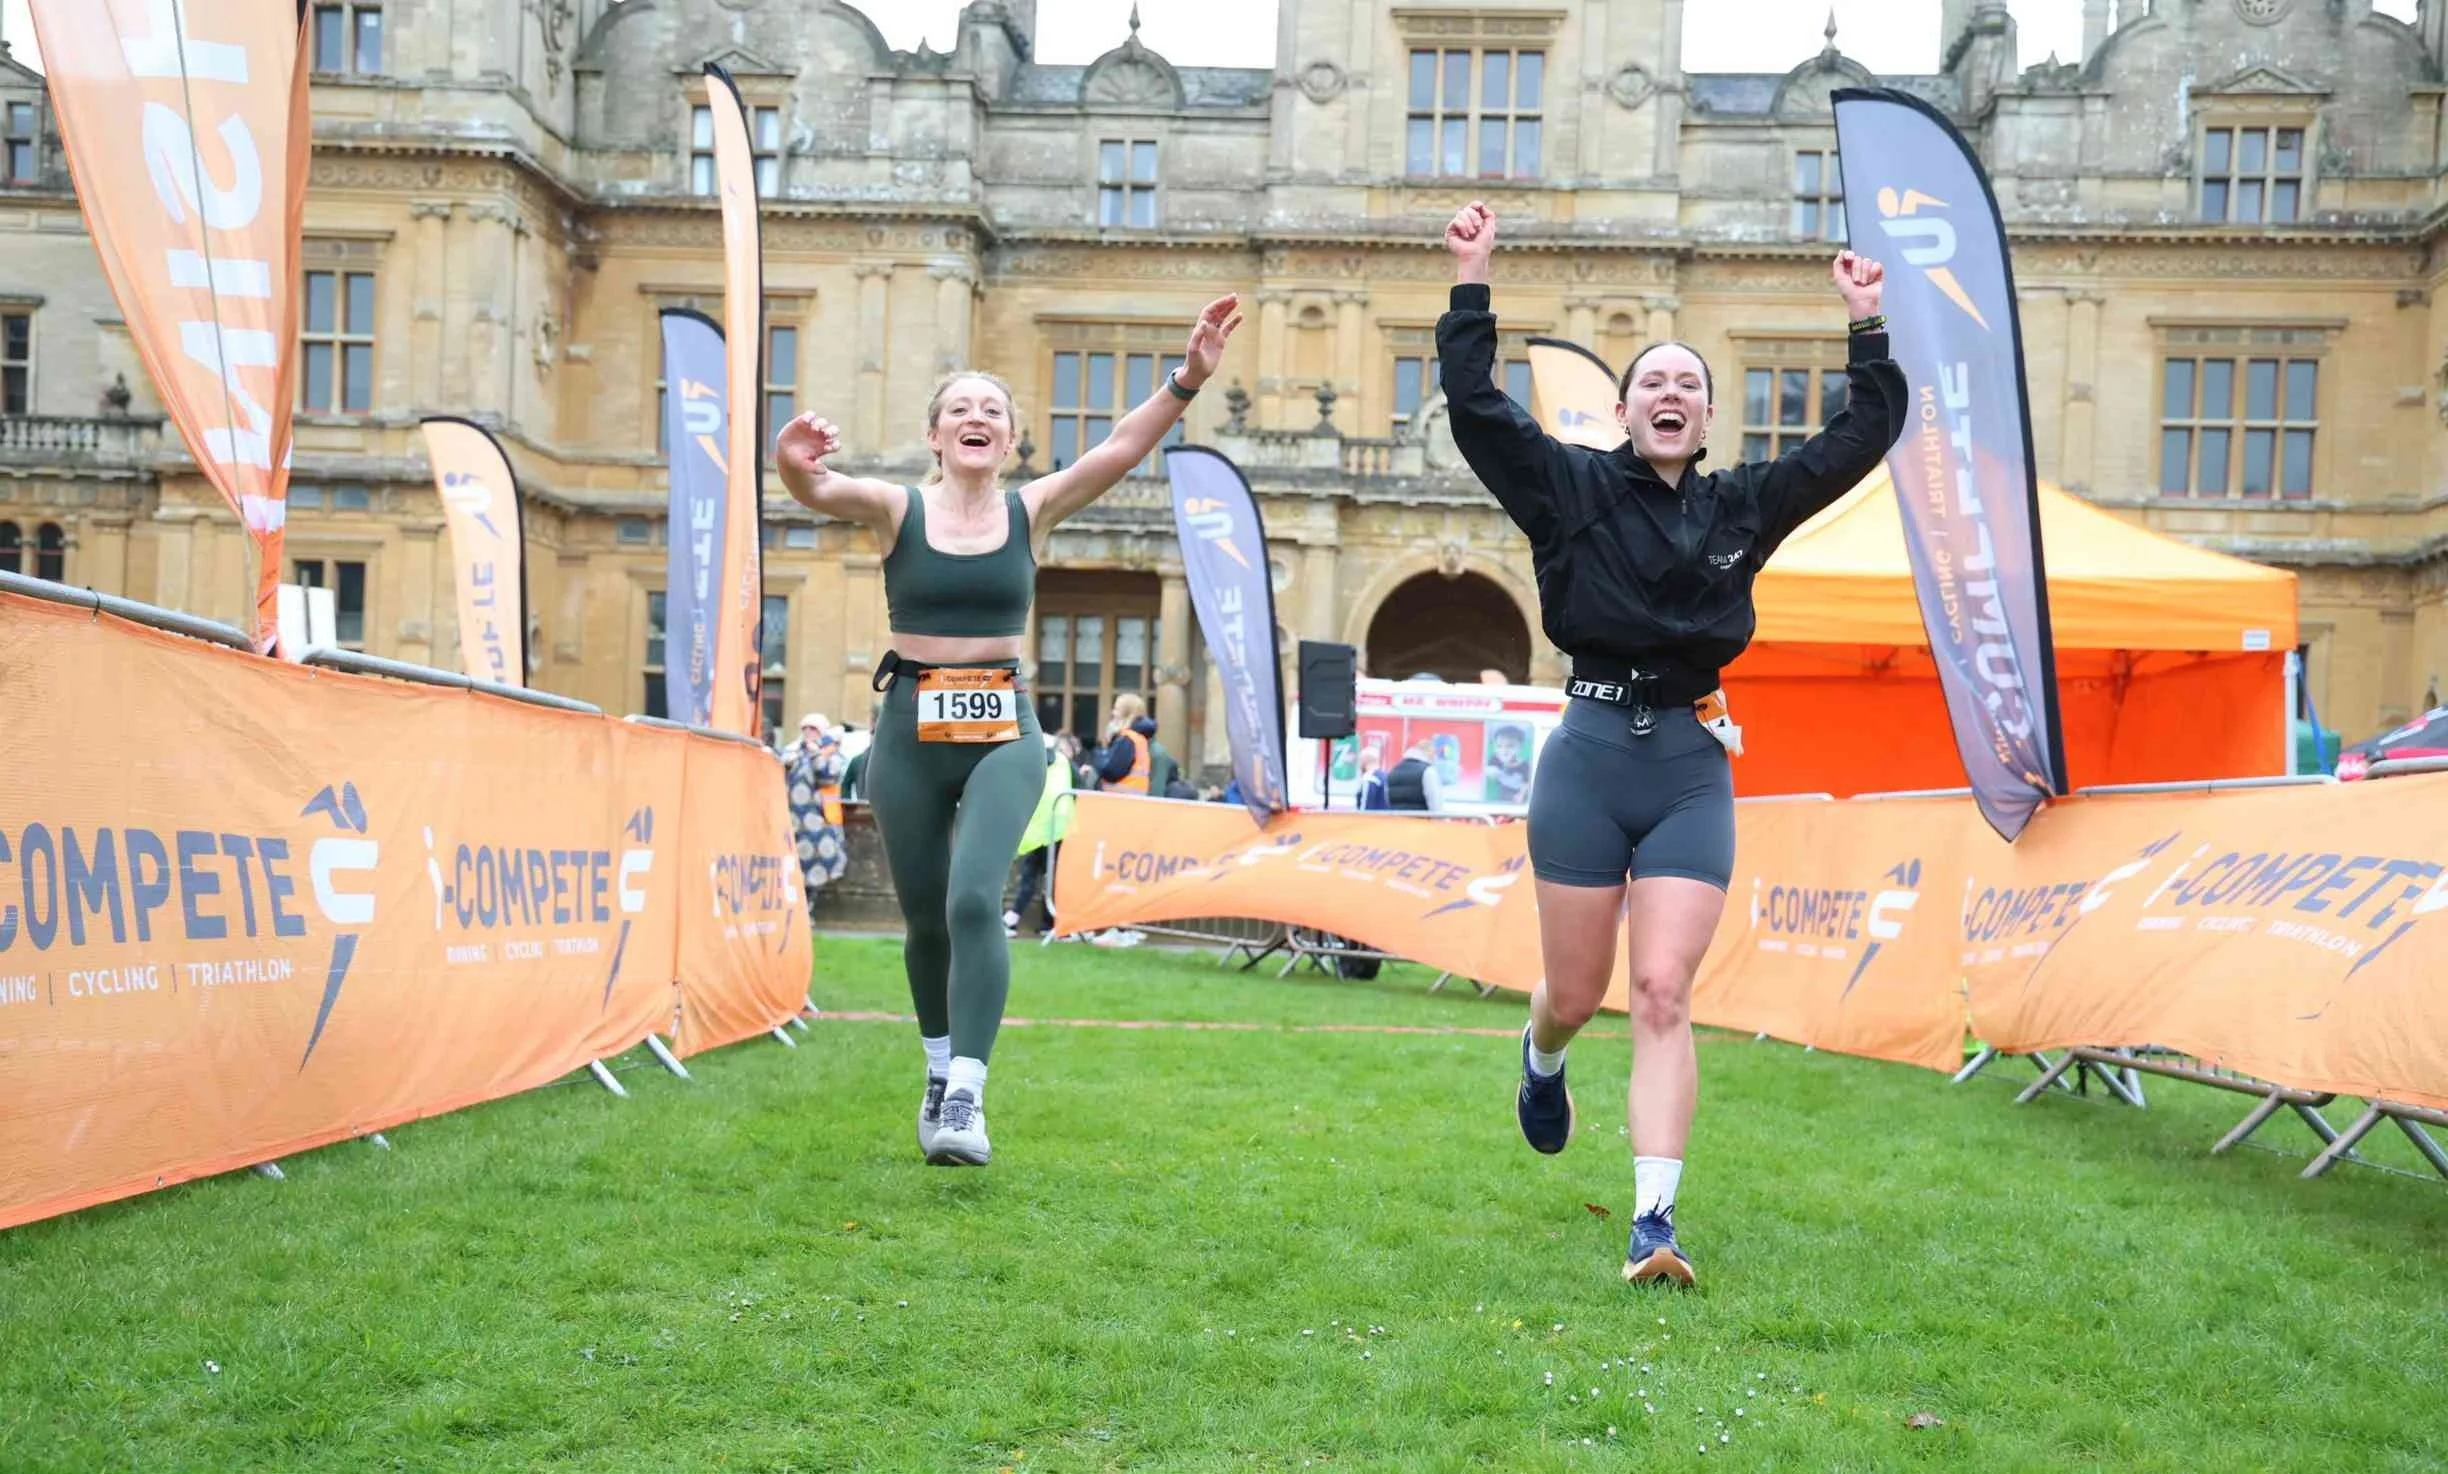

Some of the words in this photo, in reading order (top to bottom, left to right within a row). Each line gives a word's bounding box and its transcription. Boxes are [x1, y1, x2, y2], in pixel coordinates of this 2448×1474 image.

[934, 692, 1002, 719] 1599
[424, 826, 610, 931] i-COMPETE
[1750, 876, 1868, 939] i-COMPETE
[2265, 919, 2363, 958] TRIATHLON
[68, 966, 160, 997] CYCLING
[187, 958, 294, 988] TRIATHLON
